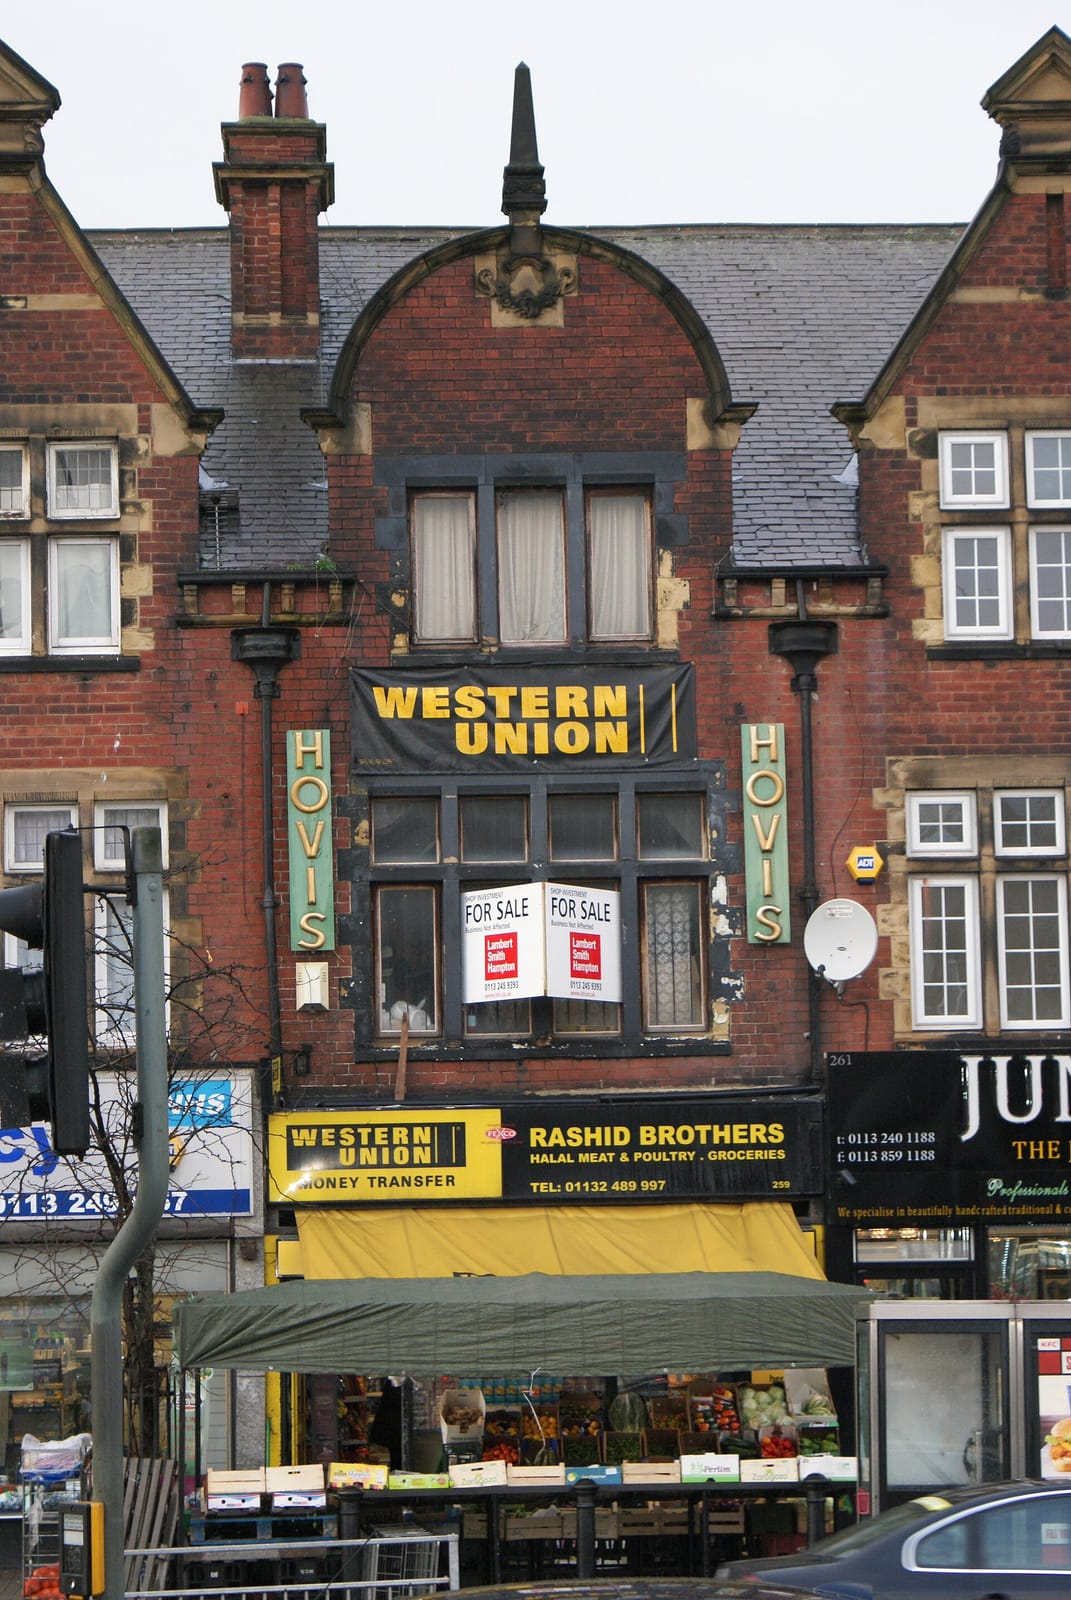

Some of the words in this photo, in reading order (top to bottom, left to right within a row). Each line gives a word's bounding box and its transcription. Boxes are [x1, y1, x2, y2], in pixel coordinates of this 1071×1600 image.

[372, 685, 628, 720] WESTERN
[455, 721, 629, 755] UNION
[290, 731, 329, 950] HOVIS
[746, 725, 785, 944] HOVIS
[857, 857, 874, 868] ADT
[466, 903, 492, 924] FOR
[496, 898, 528, 920] SALE
[551, 897, 576, 918] FOR
[581, 901, 611, 922] SALE
[488, 939, 513, 950] Lambert
[572, 937, 596, 949] Lambert
[488, 951, 505, 962] Smith
[572, 950, 590, 960] Smith
[488, 962, 516, 974] Hampton
[573, 961, 599, 973] Hampton
[484, 983, 496, 991] 0113
[570, 981, 581, 989] 0113
[830, 1055, 852, 1066] 261
[291, 1127, 431, 1147] WESTERN
[529, 1127, 631, 1147] RASHID
[639, 1123, 784, 1145] BROTHERS
[848, 1133, 877, 1144] 0113
[880, 1132, 903, 1144] 240
[907, 1132, 936, 1143] 1188
[339, 1146, 431, 1166] UNION
[530, 1153, 575, 1164] HALAL
[578, 1152, 616, 1163] MEAT
[619, 1152, 630, 1162] &
[634, 1151, 696, 1162] POULTRY
[708, 1149, 786, 1161] GROCERIES
[848, 1151, 877, 1162] 0113
[880, 1151, 903, 1162] 859
[907, 1150, 936, 1161] 1188
[1012, 1141, 1061, 1159] THE
[298, 1177, 359, 1190] MONEY
[367, 1175, 456, 1188] TRANSFER
[530, 1182, 561, 1193] TEL:
[565, 1181, 607, 1192] 01132
[611, 1181, 637, 1191] 489
[641, 1180, 666, 1191] 997
[772, 1180, 790, 1189] 259
[987, 1178, 1069, 1203] Professionals
[837, 1207, 851, 1217] We
[853, 1206, 894, 1220] specialise
[897, 1207, 905, 1217] in
[907, 1205, 953, 1218] beautifully
[1008, 1204, 1053, 1215] traditional
[1055, 1204, 1061, 1214] &
